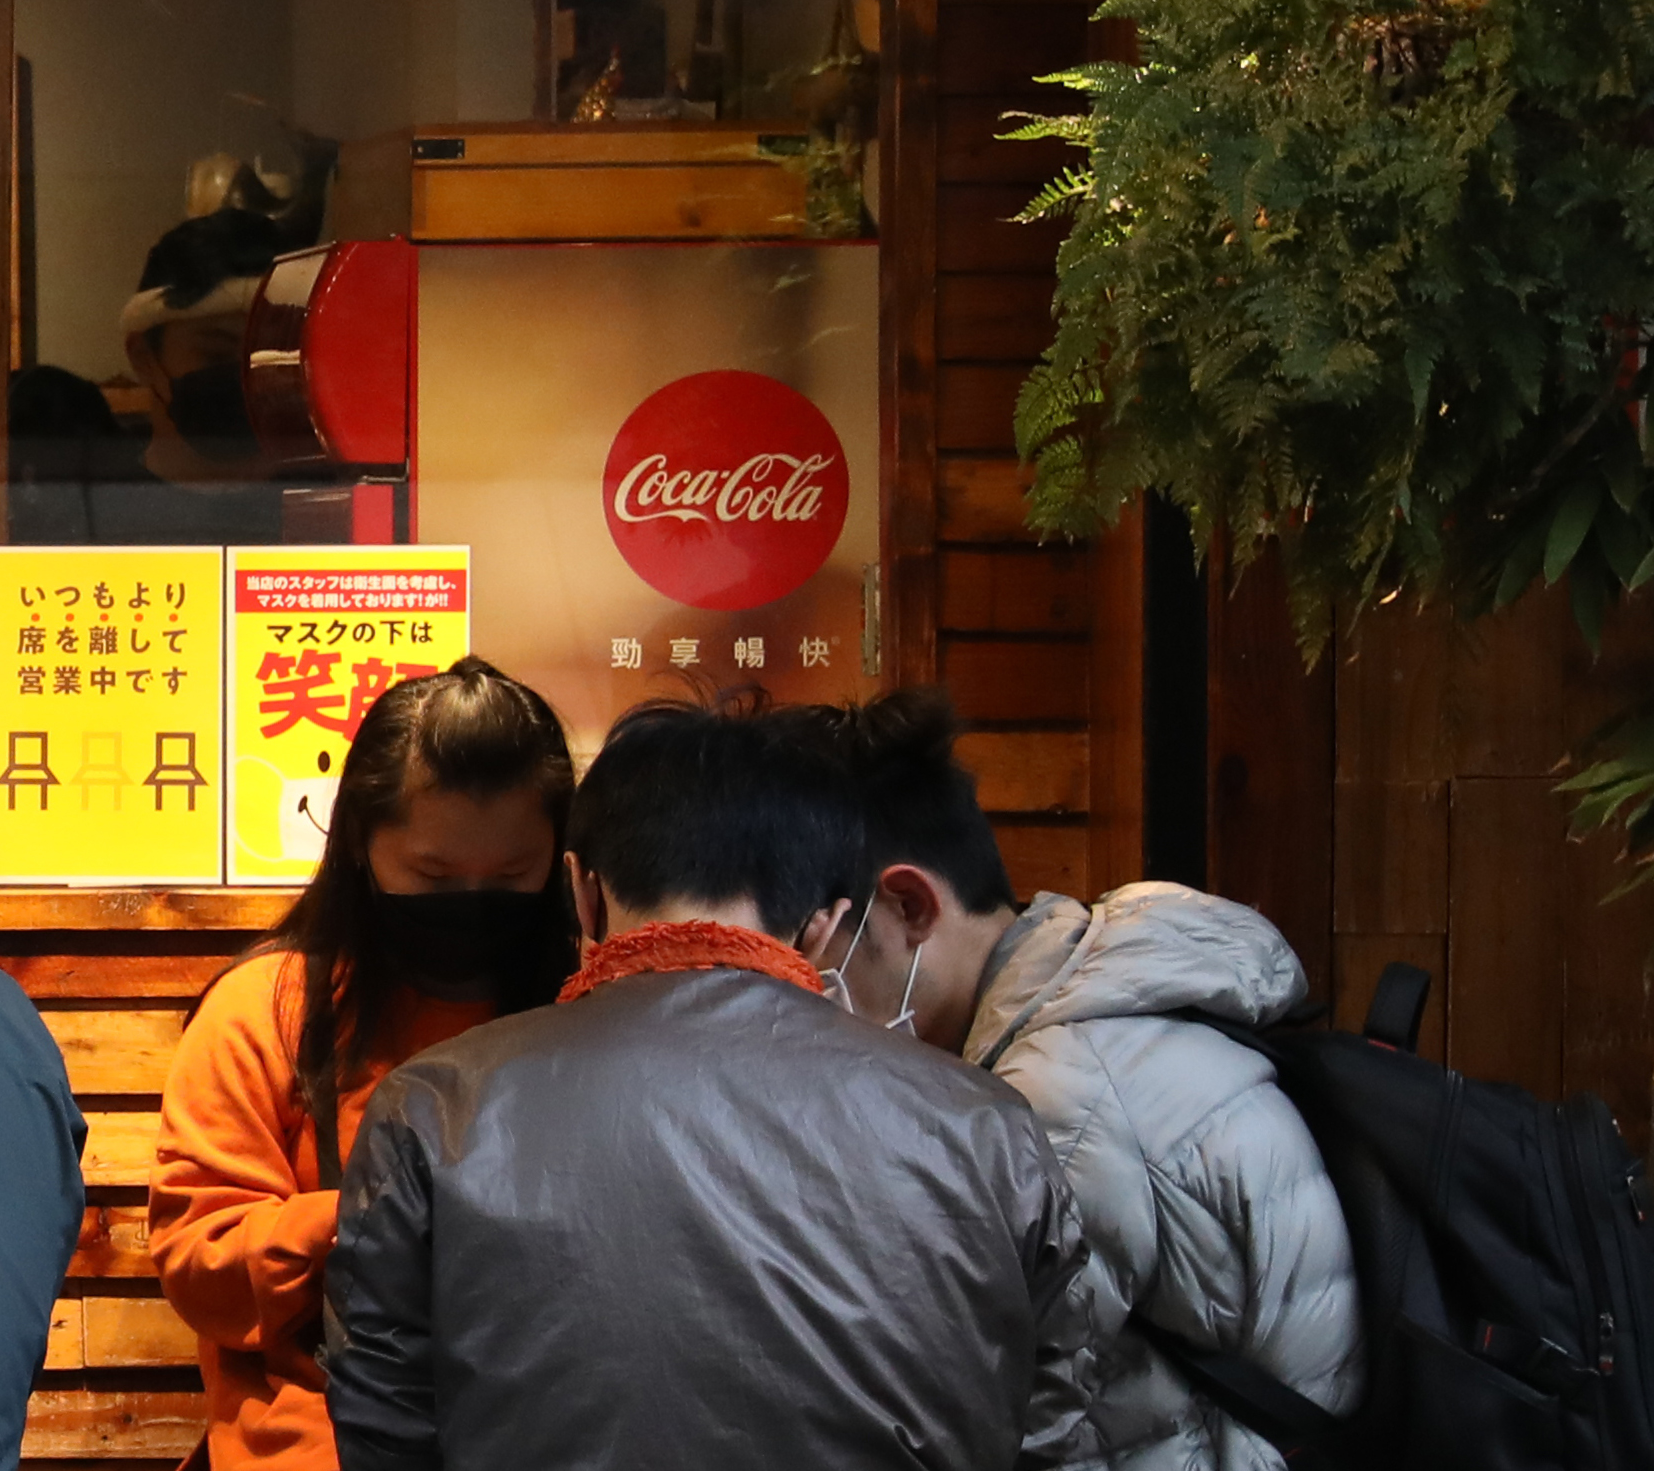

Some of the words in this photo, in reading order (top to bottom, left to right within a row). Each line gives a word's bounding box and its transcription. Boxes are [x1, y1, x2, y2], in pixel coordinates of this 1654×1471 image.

[613, 452, 836, 523] Coca-Cola
[19, 581, 187, 611] いつもより
[16, 625, 188, 656] 席を離して
[266, 619, 434, 646] マスクの下は
[610, 636, 831, 669] 勁享暢快
[16, 665, 188, 696] 営業中です
